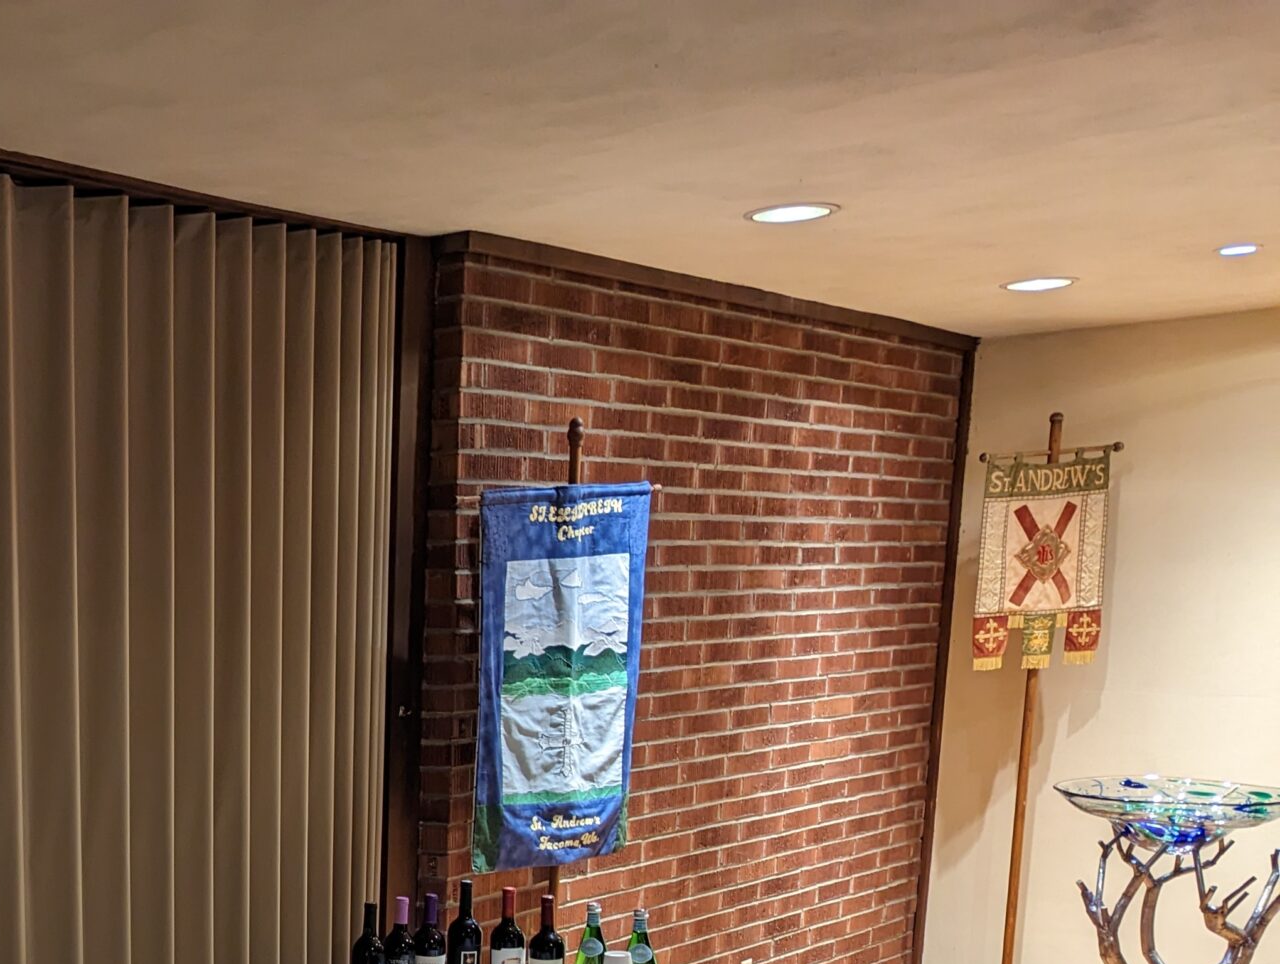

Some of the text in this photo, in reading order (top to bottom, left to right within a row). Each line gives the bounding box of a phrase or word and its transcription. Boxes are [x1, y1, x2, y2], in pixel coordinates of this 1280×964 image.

[1014, 464, 1105, 493] ANDREW'S
[558, 525, 595, 542] Chapter
[551, 814, 601, 829] Andrew's
